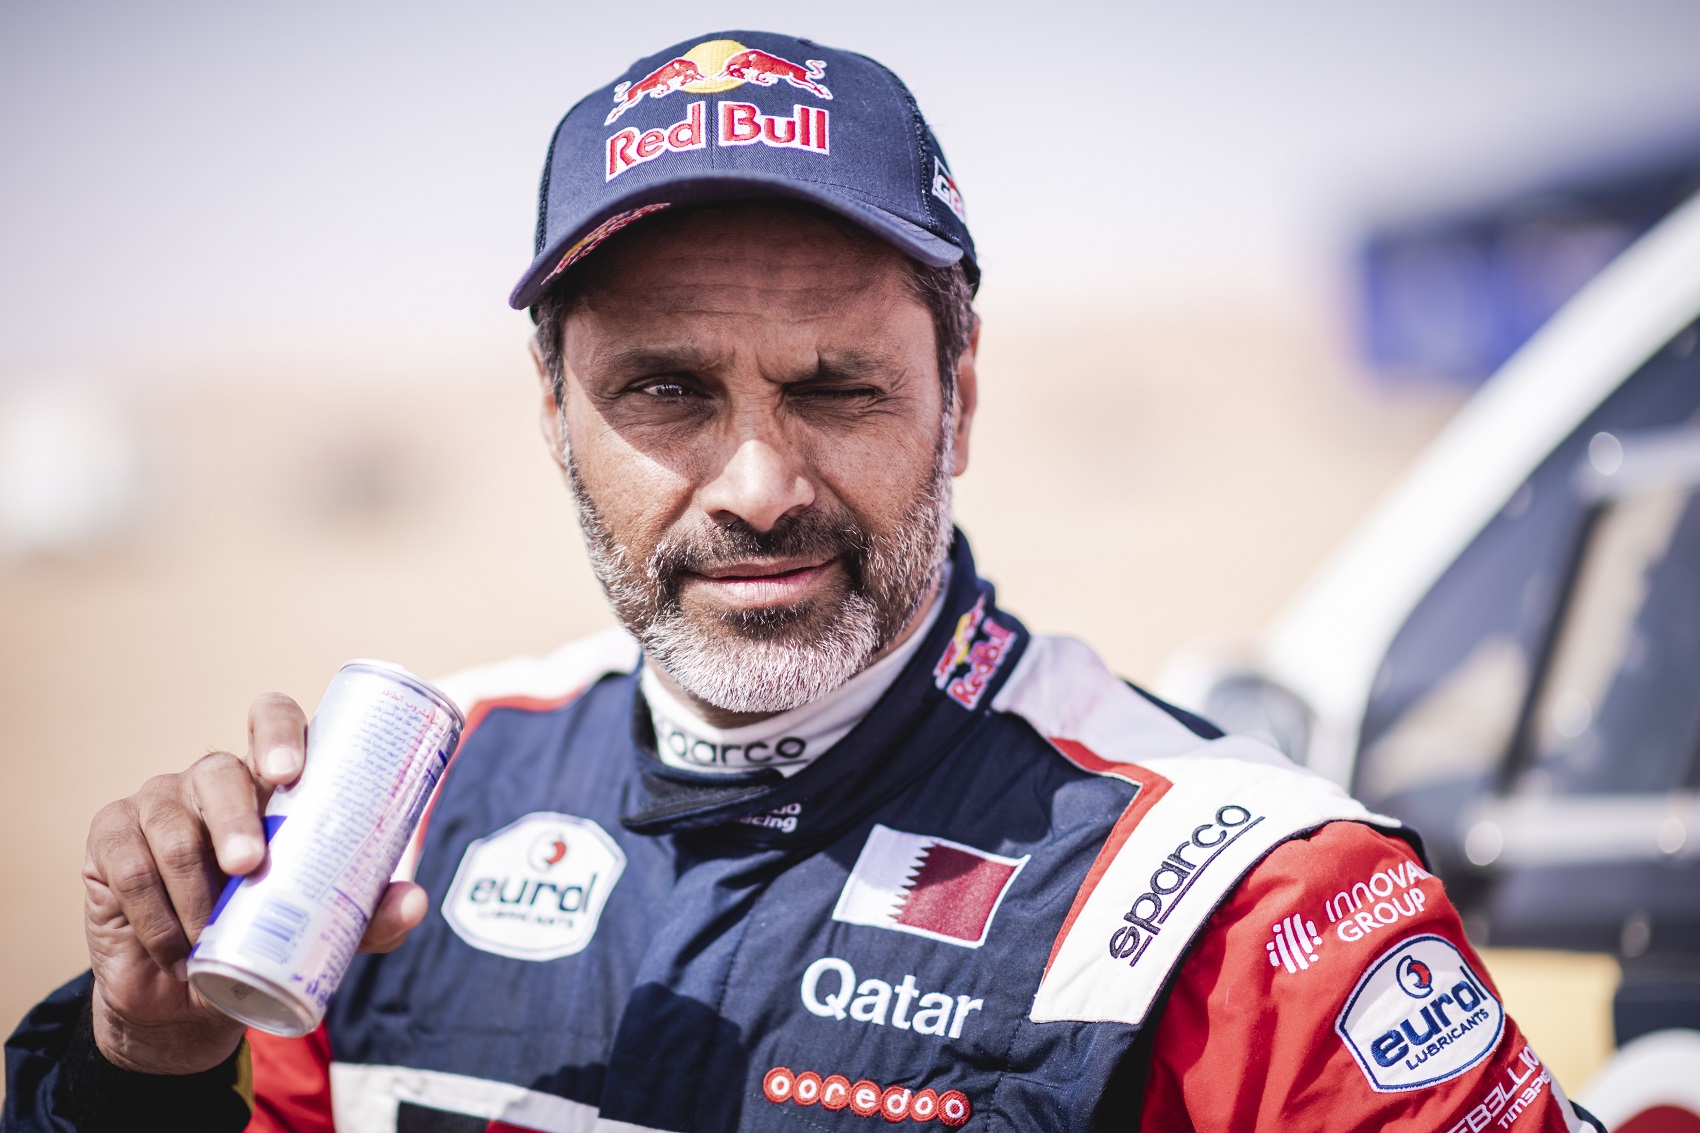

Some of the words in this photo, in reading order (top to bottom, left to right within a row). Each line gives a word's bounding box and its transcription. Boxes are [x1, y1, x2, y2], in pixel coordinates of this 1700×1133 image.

[606, 101, 706, 182] Red
[718, 101, 829, 155] Bull
[966, 617, 1017, 665] Bull
[946, 655, 998, 711] Red
[470, 872, 598, 915] eurol
[1109, 805, 1257, 964] sparco
[1337, 888, 1426, 942] GROUP
[801, 957, 984, 1039] Qatar
[1370, 965, 1488, 1068] eurol
[1405, 1008, 1490, 1071] LUBRICANTS
[766, 1071, 968, 1122] ooredoo
